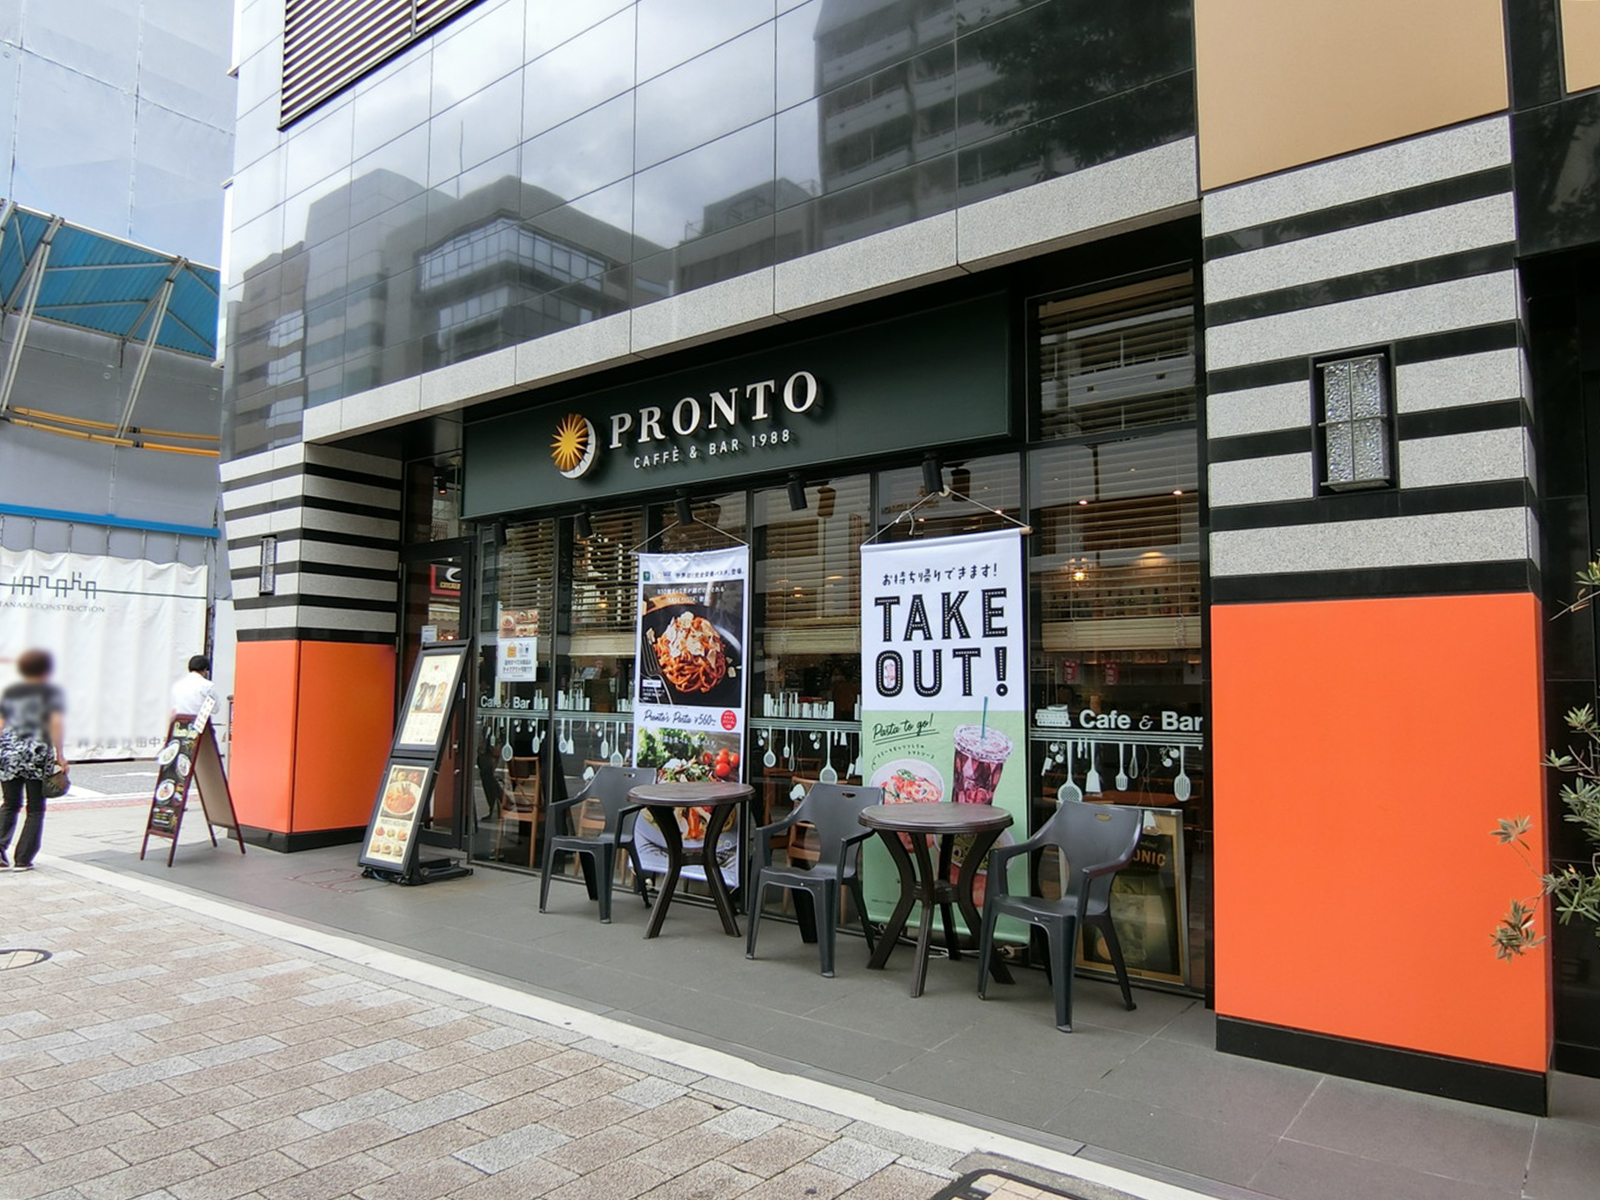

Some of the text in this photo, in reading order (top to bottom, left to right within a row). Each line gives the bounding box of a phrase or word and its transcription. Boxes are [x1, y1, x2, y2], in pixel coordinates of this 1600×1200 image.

[609, 371, 818, 449] PRONTO
[633, 429, 790, 469] CAFFÈ & BAR 1988
[35, 603, 105, 613] CONSTRUCTION
[874, 587, 1008, 642] TAKE
[875, 647, 1009, 697] OUT!
[513, 696, 531, 709] Bar
[672, 710, 692, 724] Pasta
[872, 712, 934, 740] Pasta to go!
[1079, 709, 1203, 732] Cafe & Bar
